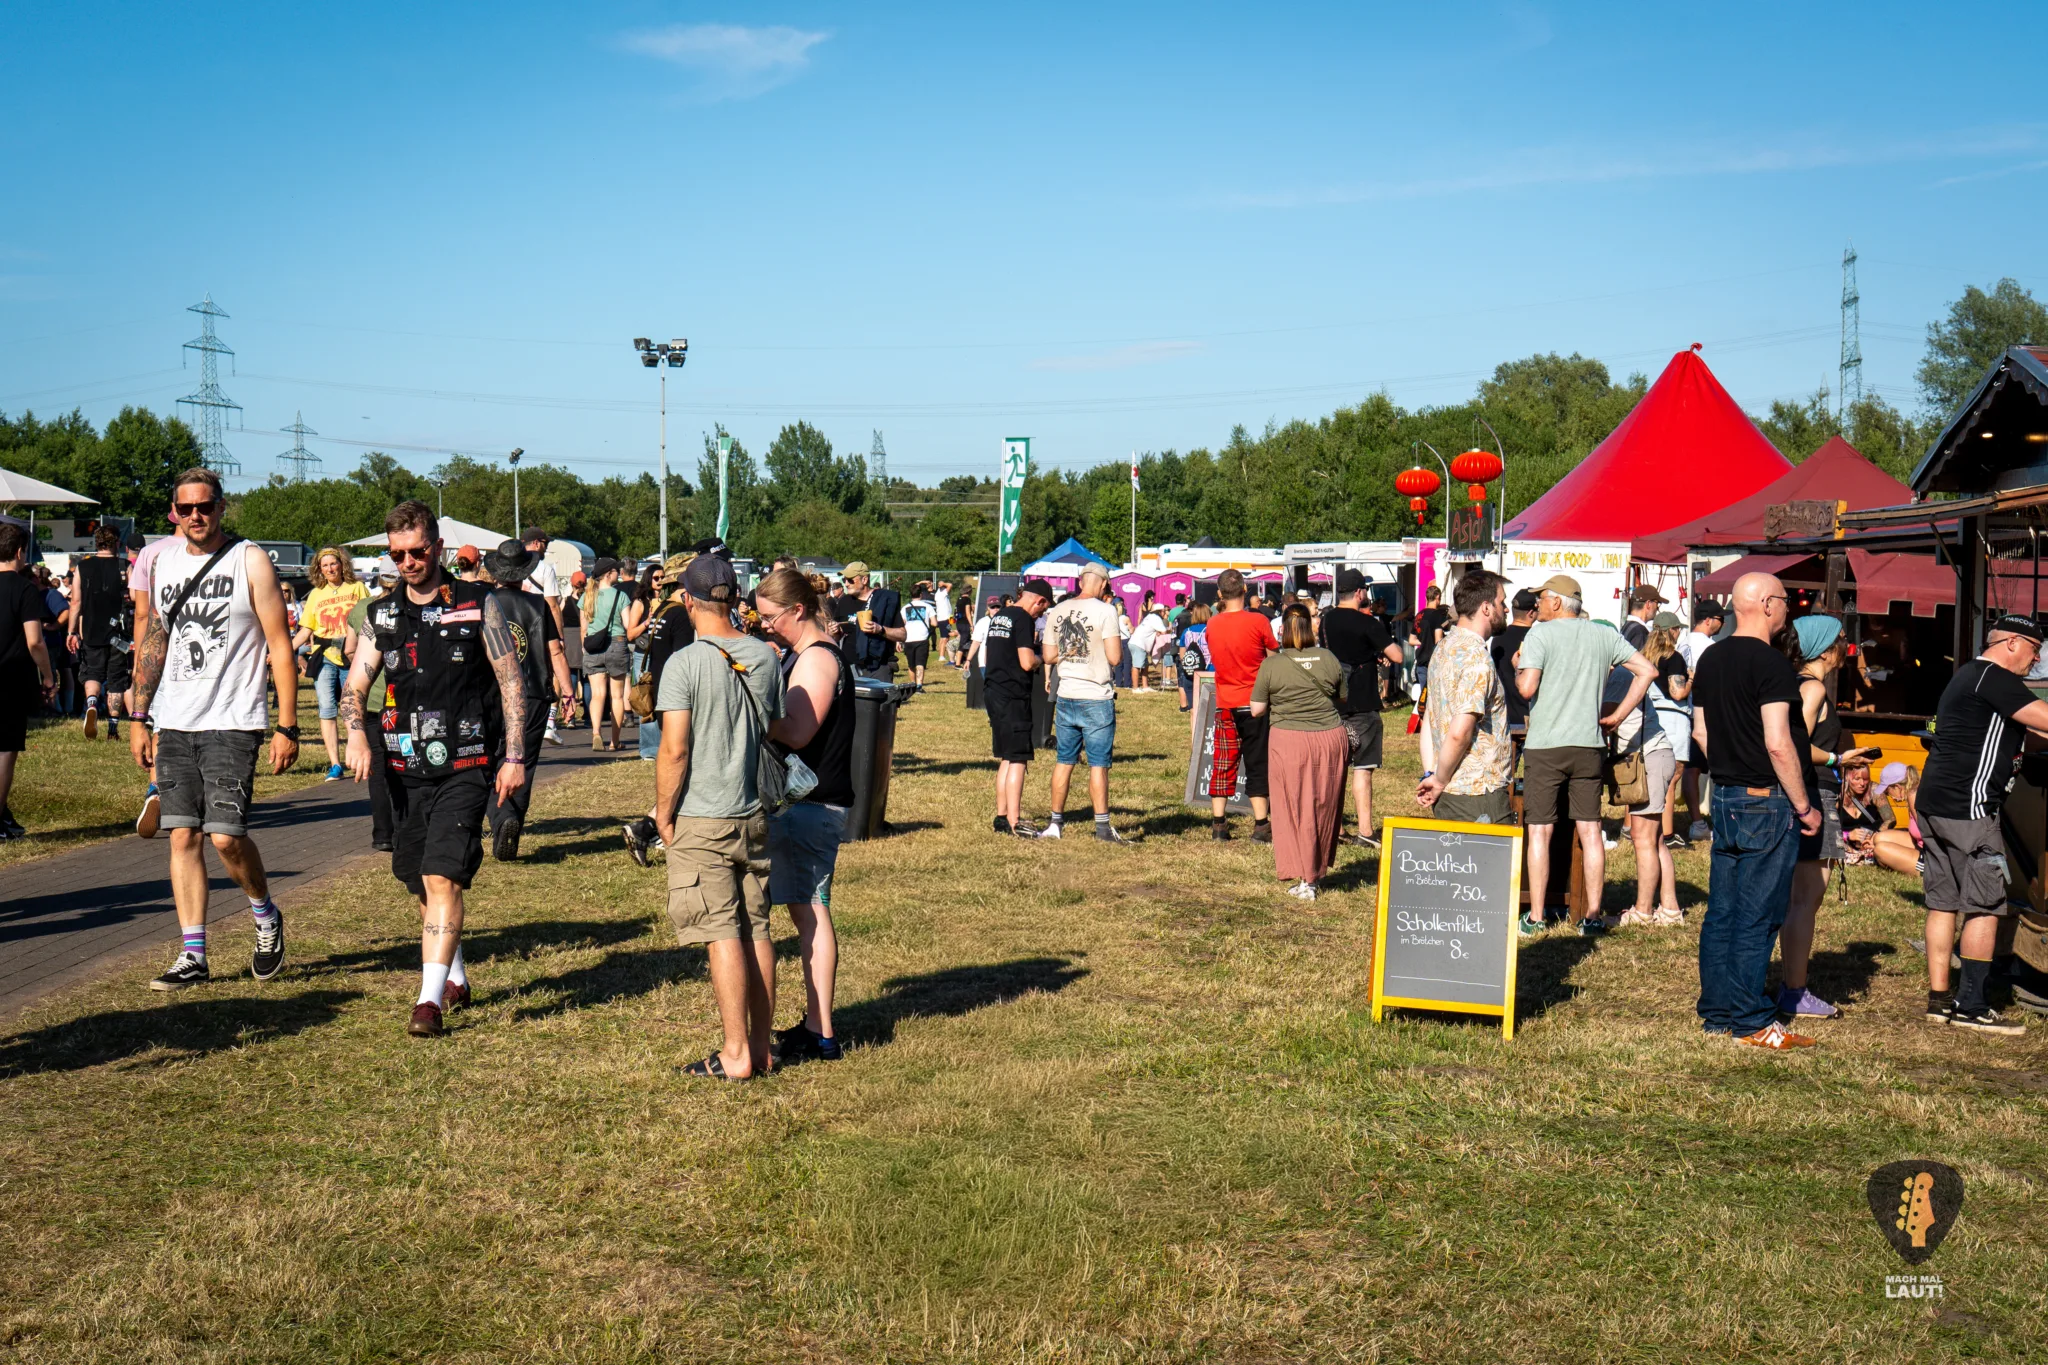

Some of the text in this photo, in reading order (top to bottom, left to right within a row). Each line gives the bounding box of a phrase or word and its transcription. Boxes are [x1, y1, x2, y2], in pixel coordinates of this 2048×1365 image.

[1451, 511, 1488, 550] Asian
[1513, 551, 1536, 567] THAI
[1539, 552, 1562, 569] WOK
[1564, 551, 1592, 568] FOOD
[1600, 553, 1622, 568] THAI
[1053, 609, 1094, 634] NO FEAR
[2005, 617, 2034, 627] PASCOW
[508, 624, 526, 647] ADCLUB
[1397, 850, 1477, 873] Backfisch
[1405, 874, 1447, 886] im Brötchen
[1397, 911, 1484, 934] Schollenfilet
[1400, 934, 1444, 946] im Brötchen
